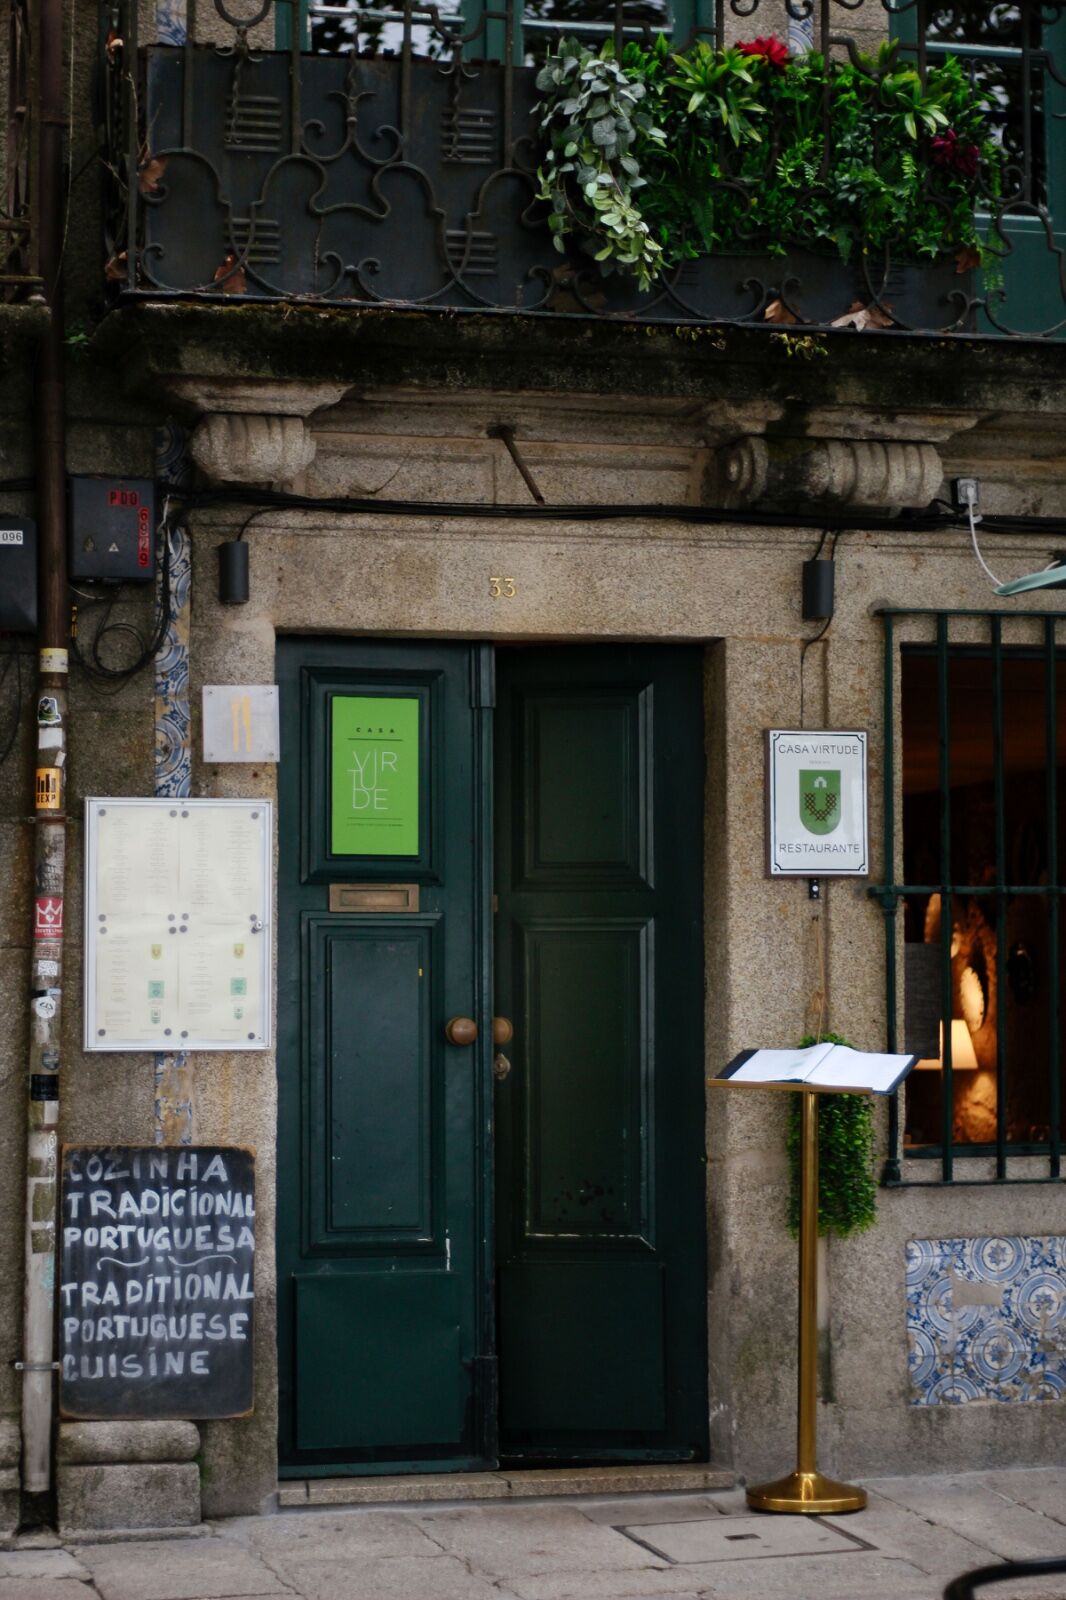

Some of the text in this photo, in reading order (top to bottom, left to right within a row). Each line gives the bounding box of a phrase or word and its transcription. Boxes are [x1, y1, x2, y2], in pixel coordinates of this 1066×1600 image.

[2, 532, 22, 542] 096
[489, 577, 516, 598] 33
[778, 744, 859, 755] CASA VIRTUDE
[779, 844, 860, 854] RESTAURANTE
[69, 1152, 229, 1182] COZINHA
[63, 1224, 255, 1251] PORTUGUESA
[63, 1312, 249, 1343] PORTUGUESE
